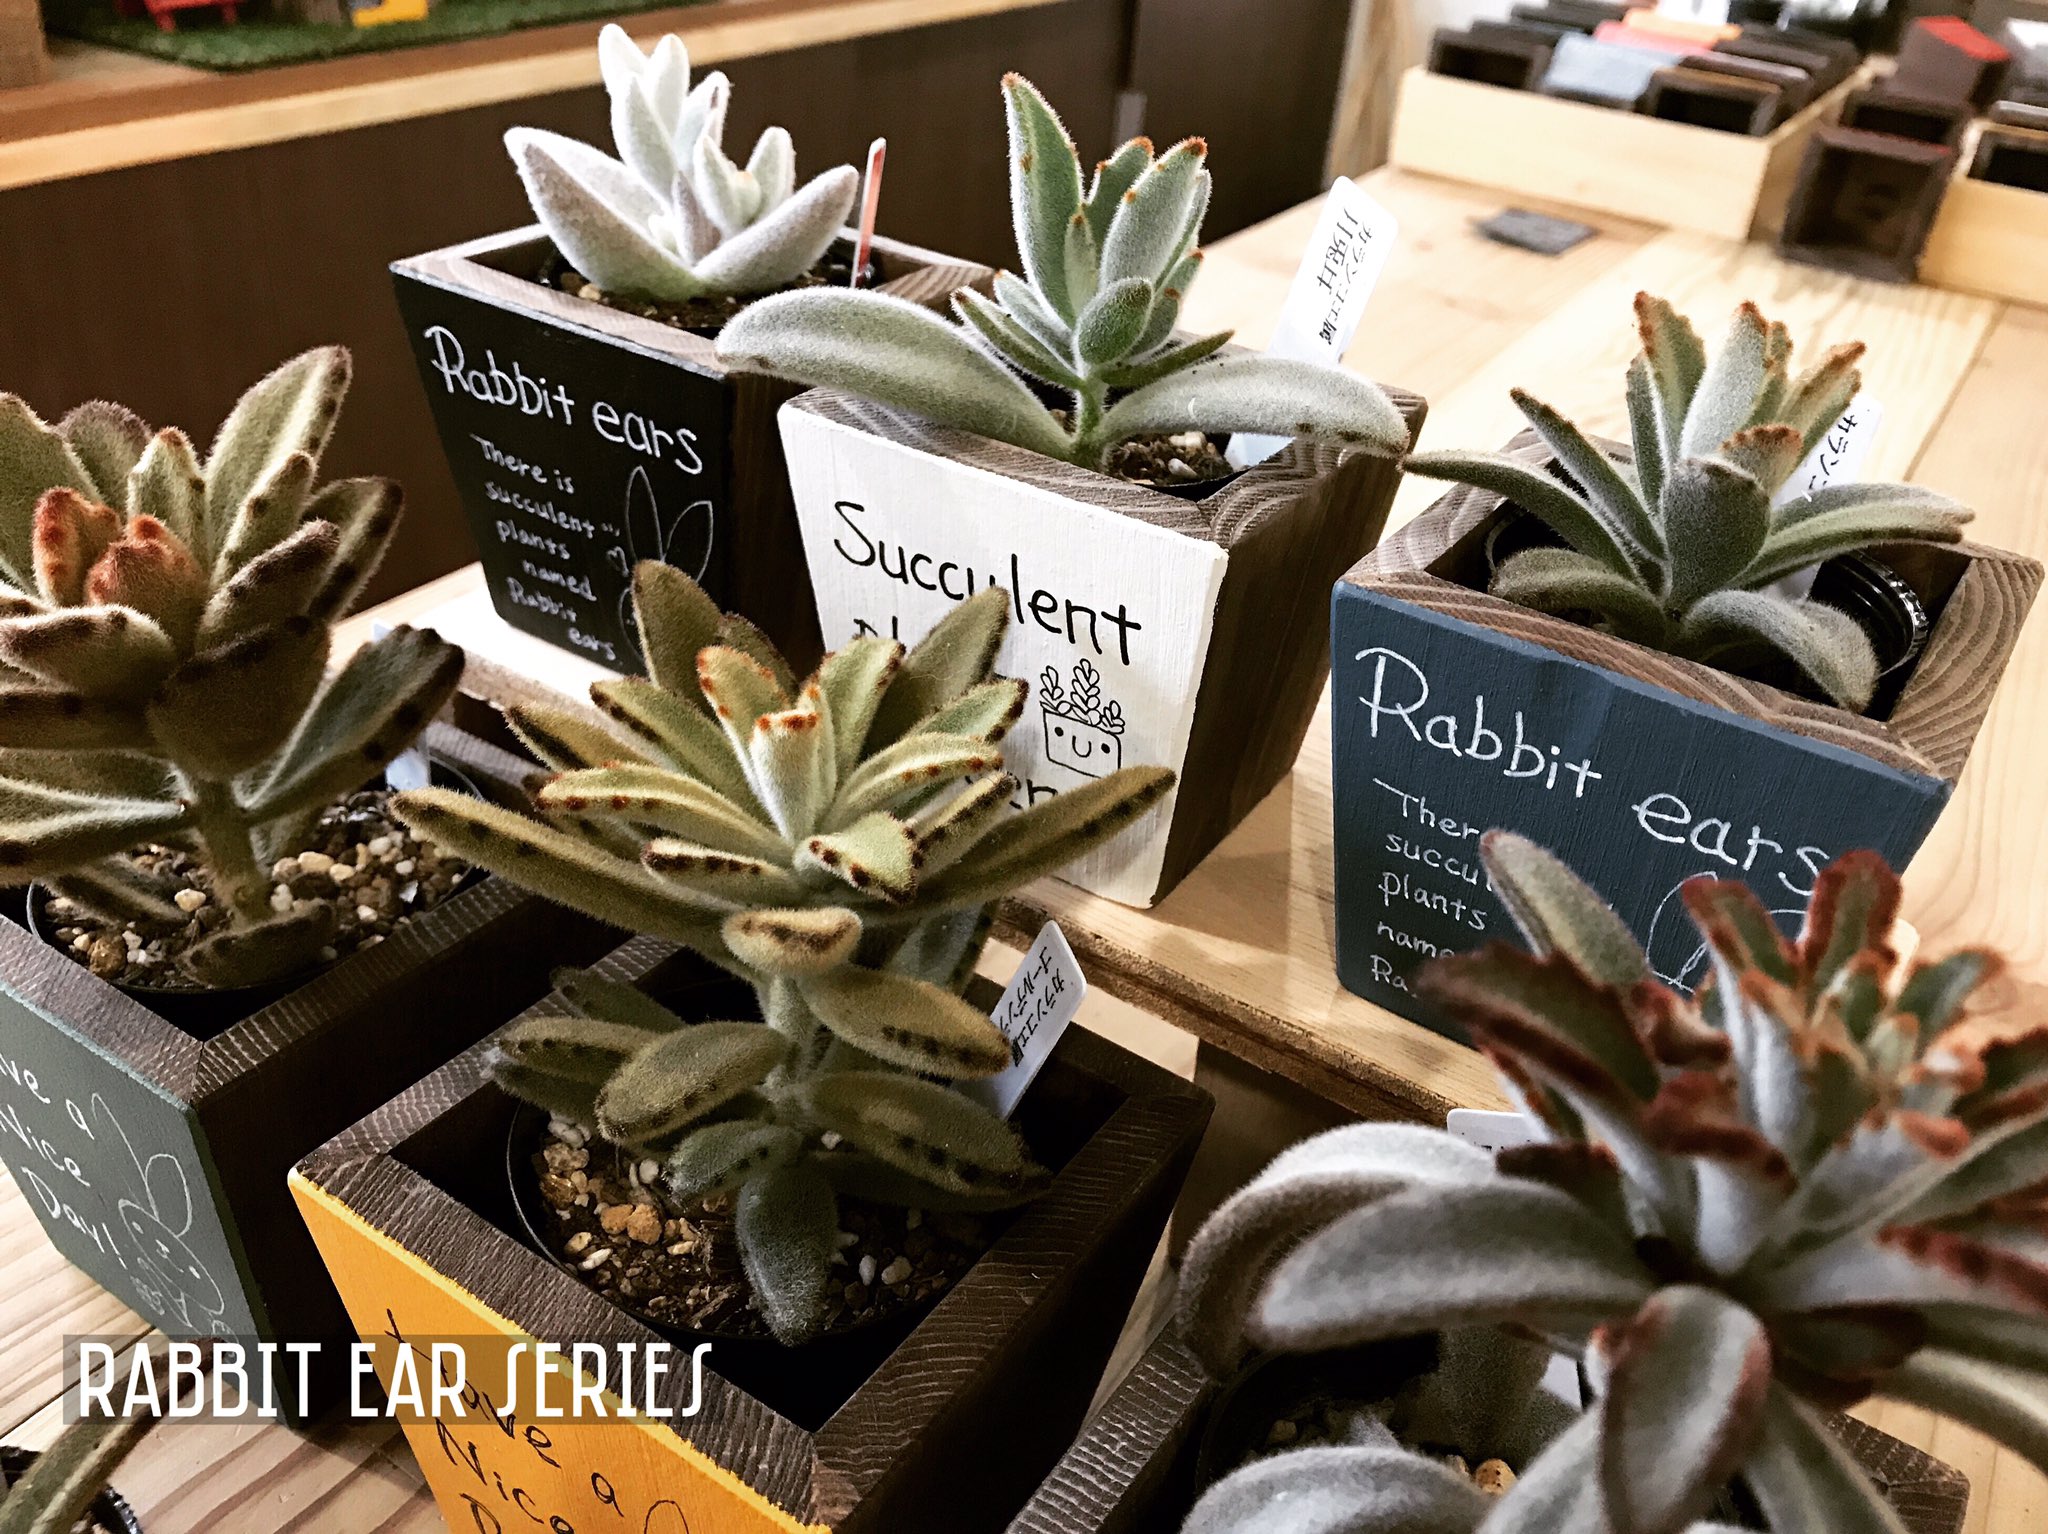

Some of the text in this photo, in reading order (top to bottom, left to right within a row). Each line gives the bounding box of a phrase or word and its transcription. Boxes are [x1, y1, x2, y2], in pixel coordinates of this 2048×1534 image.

[424, 325, 703, 474] Rabbit ears
[470, 433, 575, 494] There is
[484, 481, 597, 540] succulent
[495, 520, 571, 560] plants
[505, 576, 578, 623] Rabbit
[522, 559, 597, 601] named
[567, 627, 617, 661] ears
[1355, 646, 1832, 898] Rabbit ears
[1372, 778, 1481, 840] Ther
[1385, 833, 1492, 892] succu
[1378, 871, 1488, 931] plants
[0, 1052, 95, 1140] ve a
[0, 1104, 91, 1188] Nice
[21, 1166, 128, 1270] Day!
[591, 1471, 625, 1518] a
